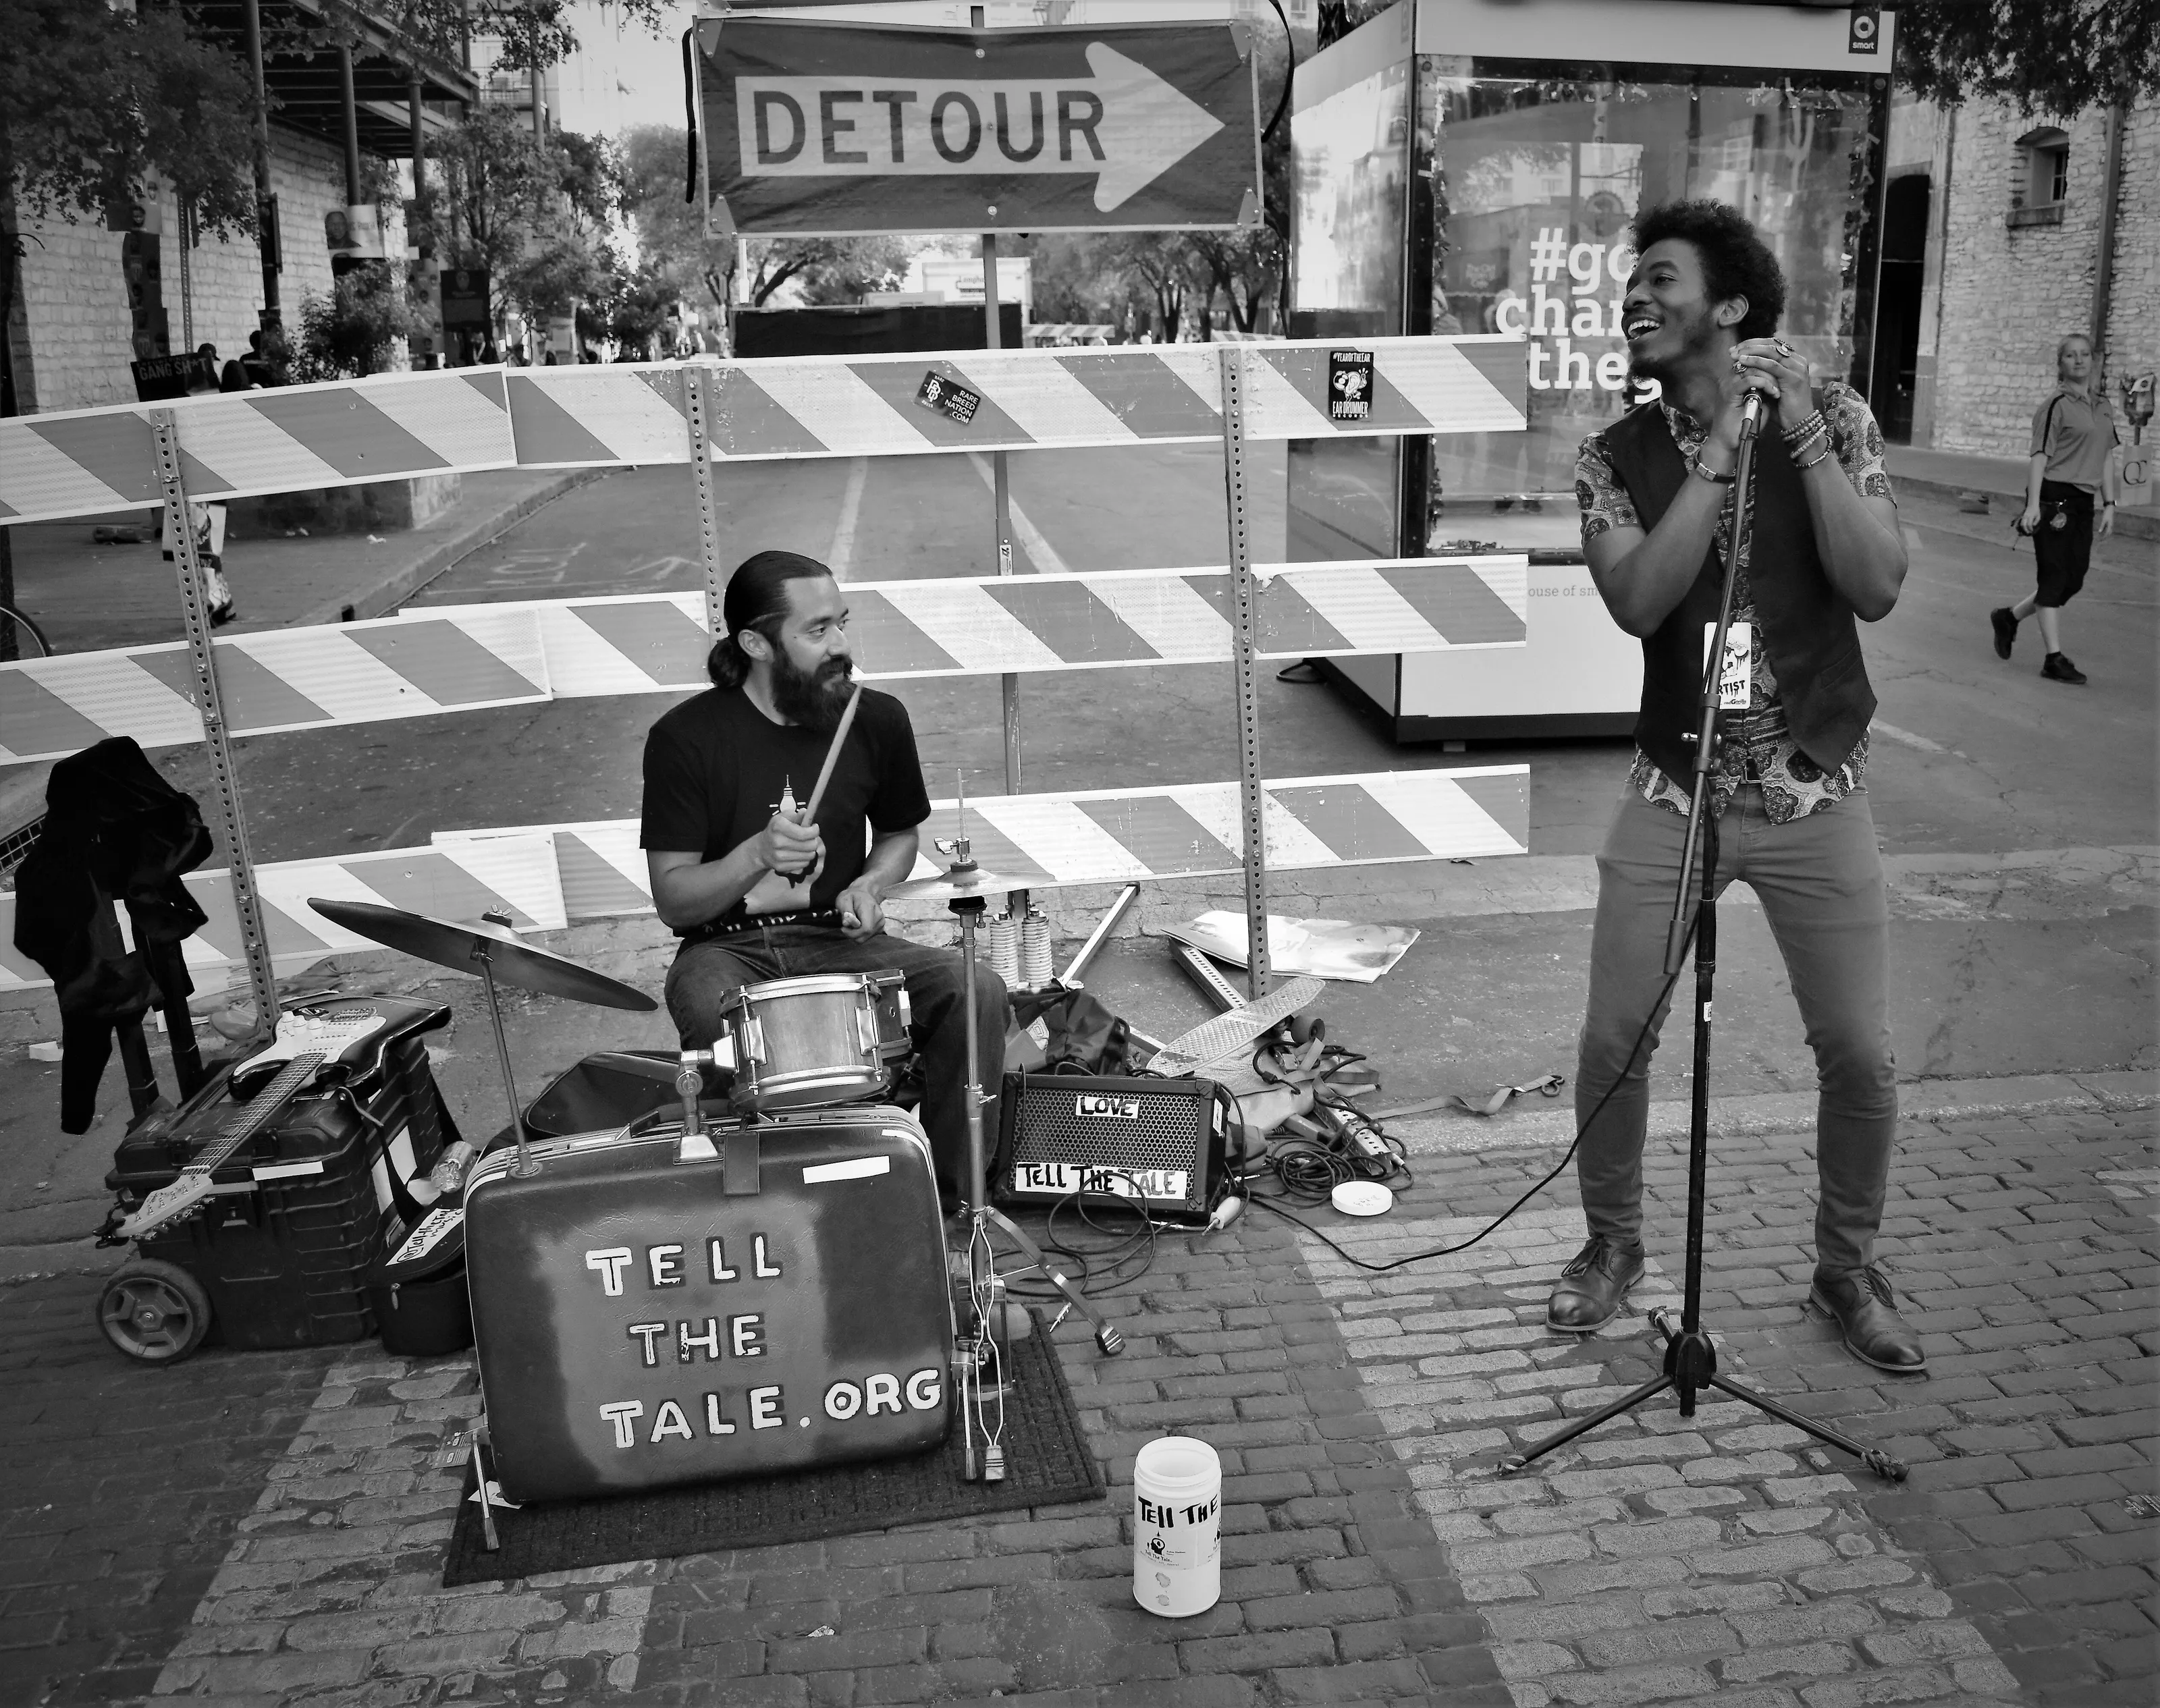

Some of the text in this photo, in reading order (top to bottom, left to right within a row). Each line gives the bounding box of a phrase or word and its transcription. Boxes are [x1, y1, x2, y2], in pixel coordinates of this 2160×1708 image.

[753, 90, 1107, 165] DETOUR
[138, 362, 173, 381] GANG
[951, 394, 975, 410] BREED
[959, 390, 979, 405] RARE
[944, 399, 973, 418] NATION
[949, 411, 970, 424] .COM
[1563, 585, 1575, 597] of
[1717, 680, 1746, 698] RTIST
[1080, 1096, 1139, 1116] LOVE
[1017, 1163, 1177, 1196] TELL THE TALE
[585, 1234, 782, 1296] TELL
[629, 1315, 761, 1365] THE
[599, 1369, 942, 1449] TALE.ORG
